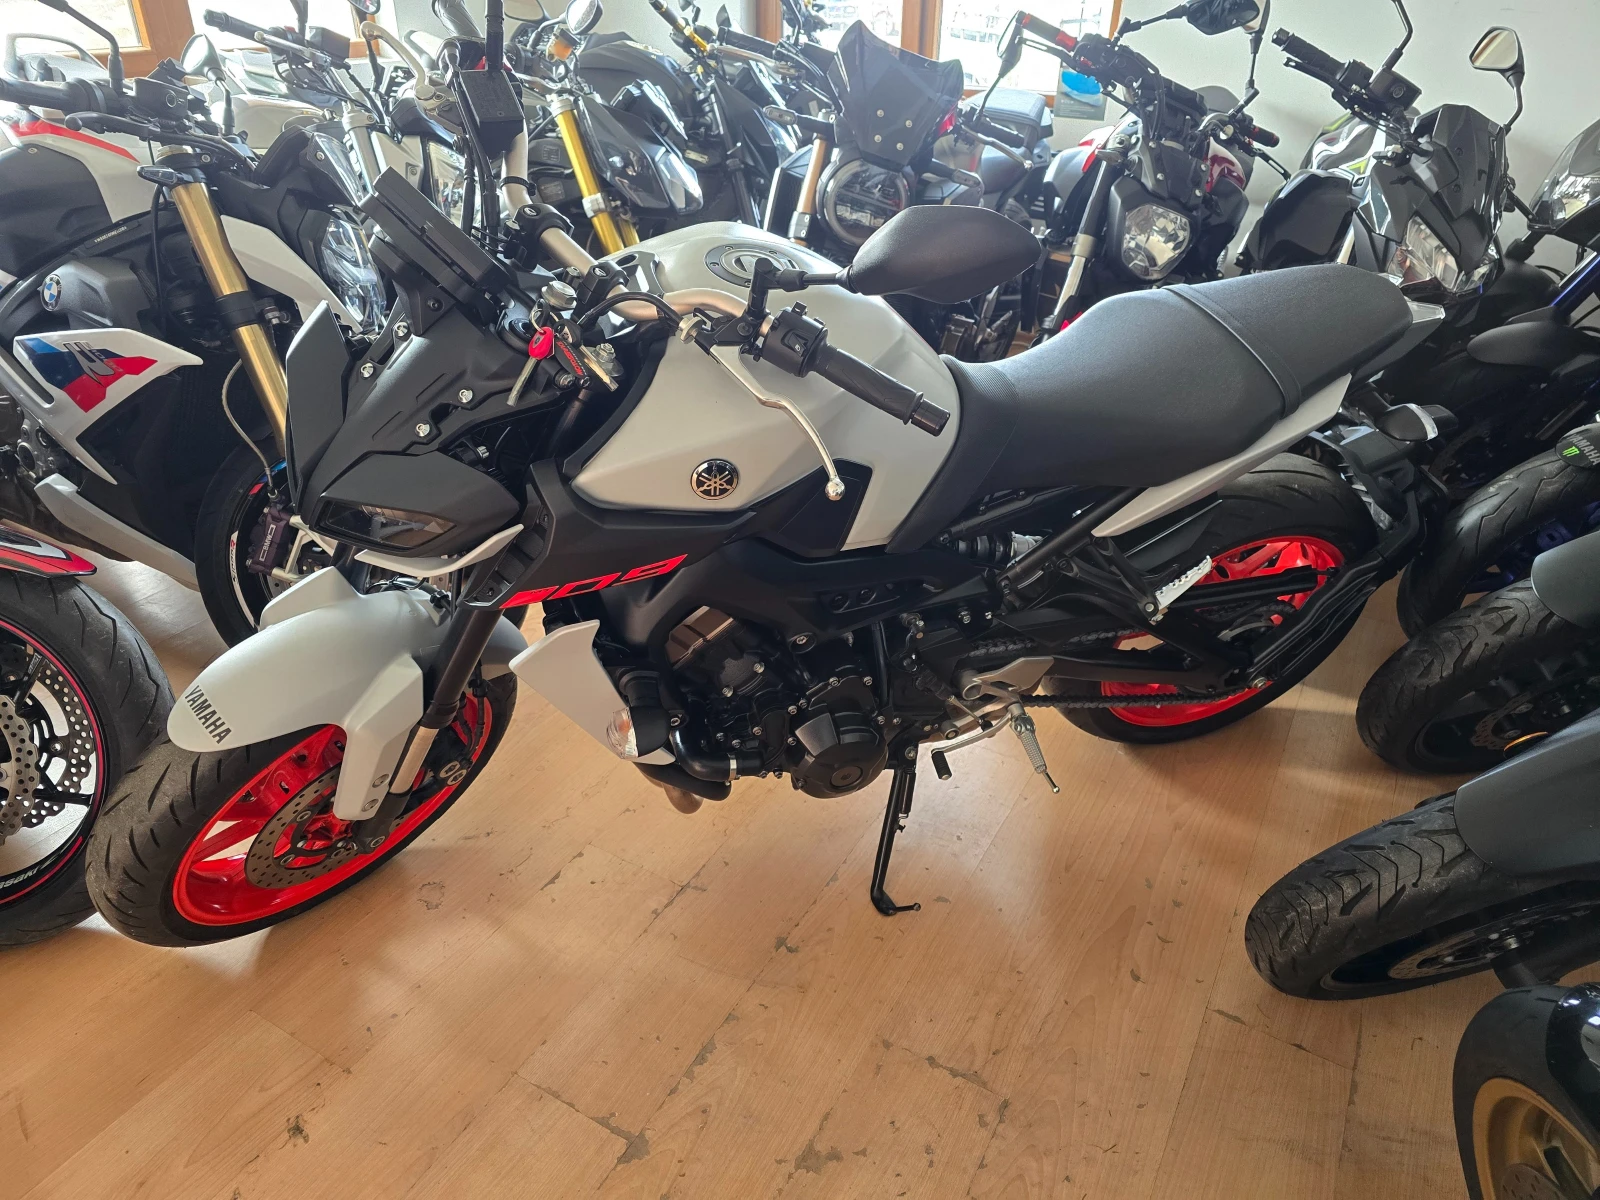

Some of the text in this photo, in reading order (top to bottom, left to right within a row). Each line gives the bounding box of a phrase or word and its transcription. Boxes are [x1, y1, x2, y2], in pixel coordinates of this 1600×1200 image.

[1567, 434, 1600, 466] YAMAHA
[263, 533, 273, 551] BMW
[185, 685, 232, 744] YAMAHA
